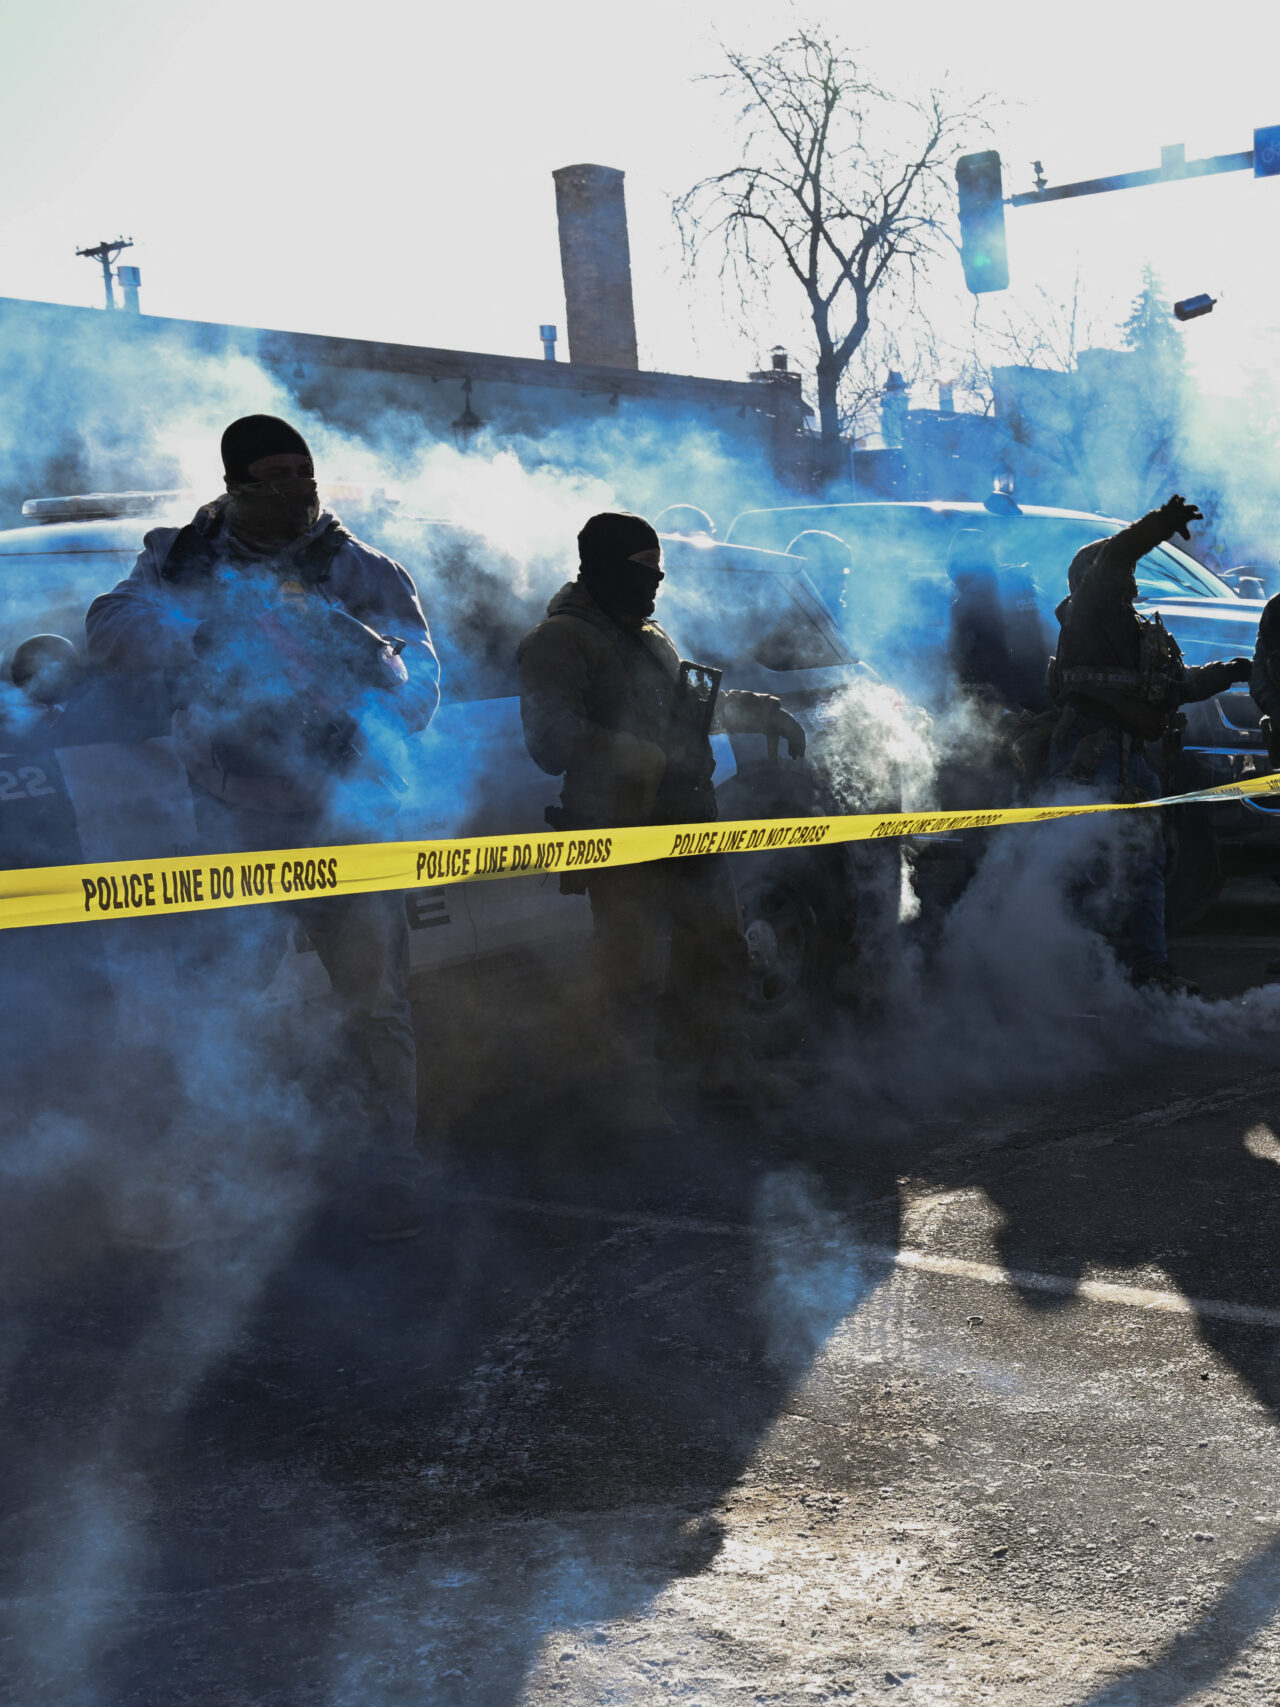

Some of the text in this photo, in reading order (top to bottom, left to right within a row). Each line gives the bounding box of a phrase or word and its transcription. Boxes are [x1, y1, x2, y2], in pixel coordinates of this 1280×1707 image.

[669, 825, 830, 856] POLICE LINE DO NOT CROSS
[870, 820, 913, 837] POLICE
[416, 838, 612, 880] POLICE LINE DO NOT CROSS
[82, 858, 338, 911] POLICE LINE DO NOT CROSS
